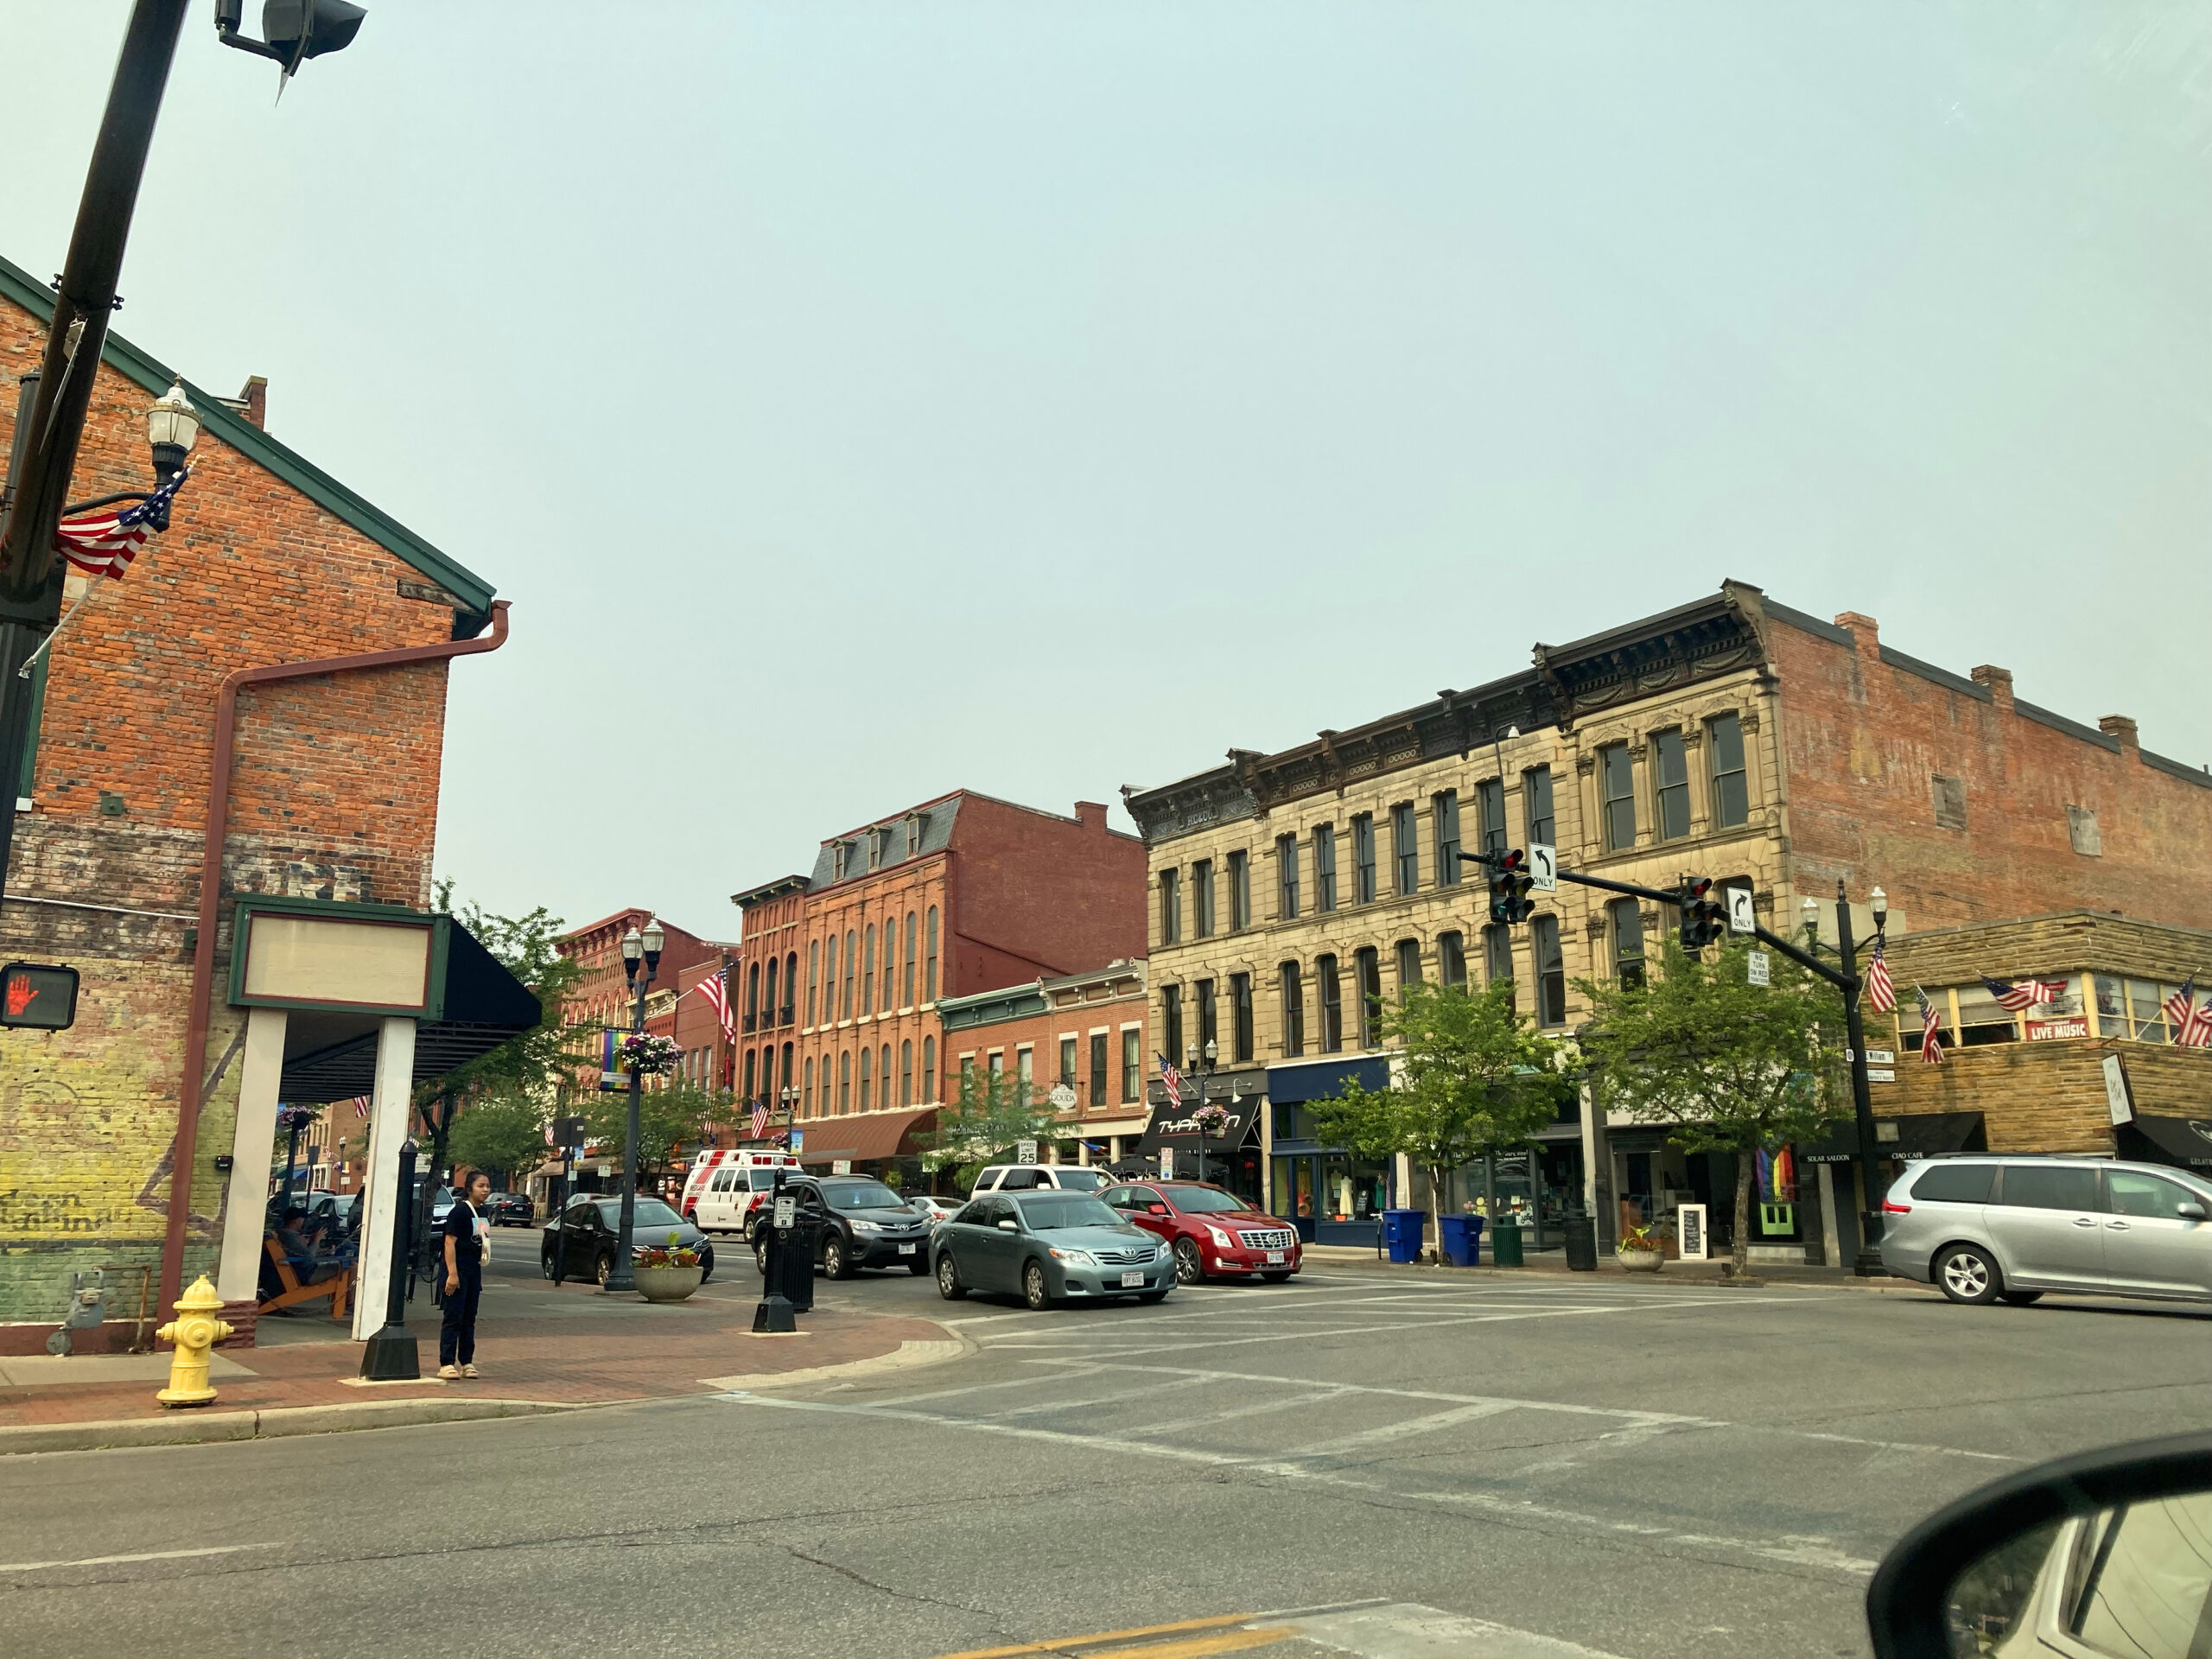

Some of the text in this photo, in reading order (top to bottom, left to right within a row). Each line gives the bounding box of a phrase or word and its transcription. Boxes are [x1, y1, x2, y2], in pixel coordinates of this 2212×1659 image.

[1534, 876, 1553, 887] ONLY
[1733, 918, 1751, 929] ONLY
[2031, 1023, 2087, 1040] LIVE MUSIC
[1051, 1093, 1076, 1103] GOUDA
[1020, 1153, 1035, 1163] 25
